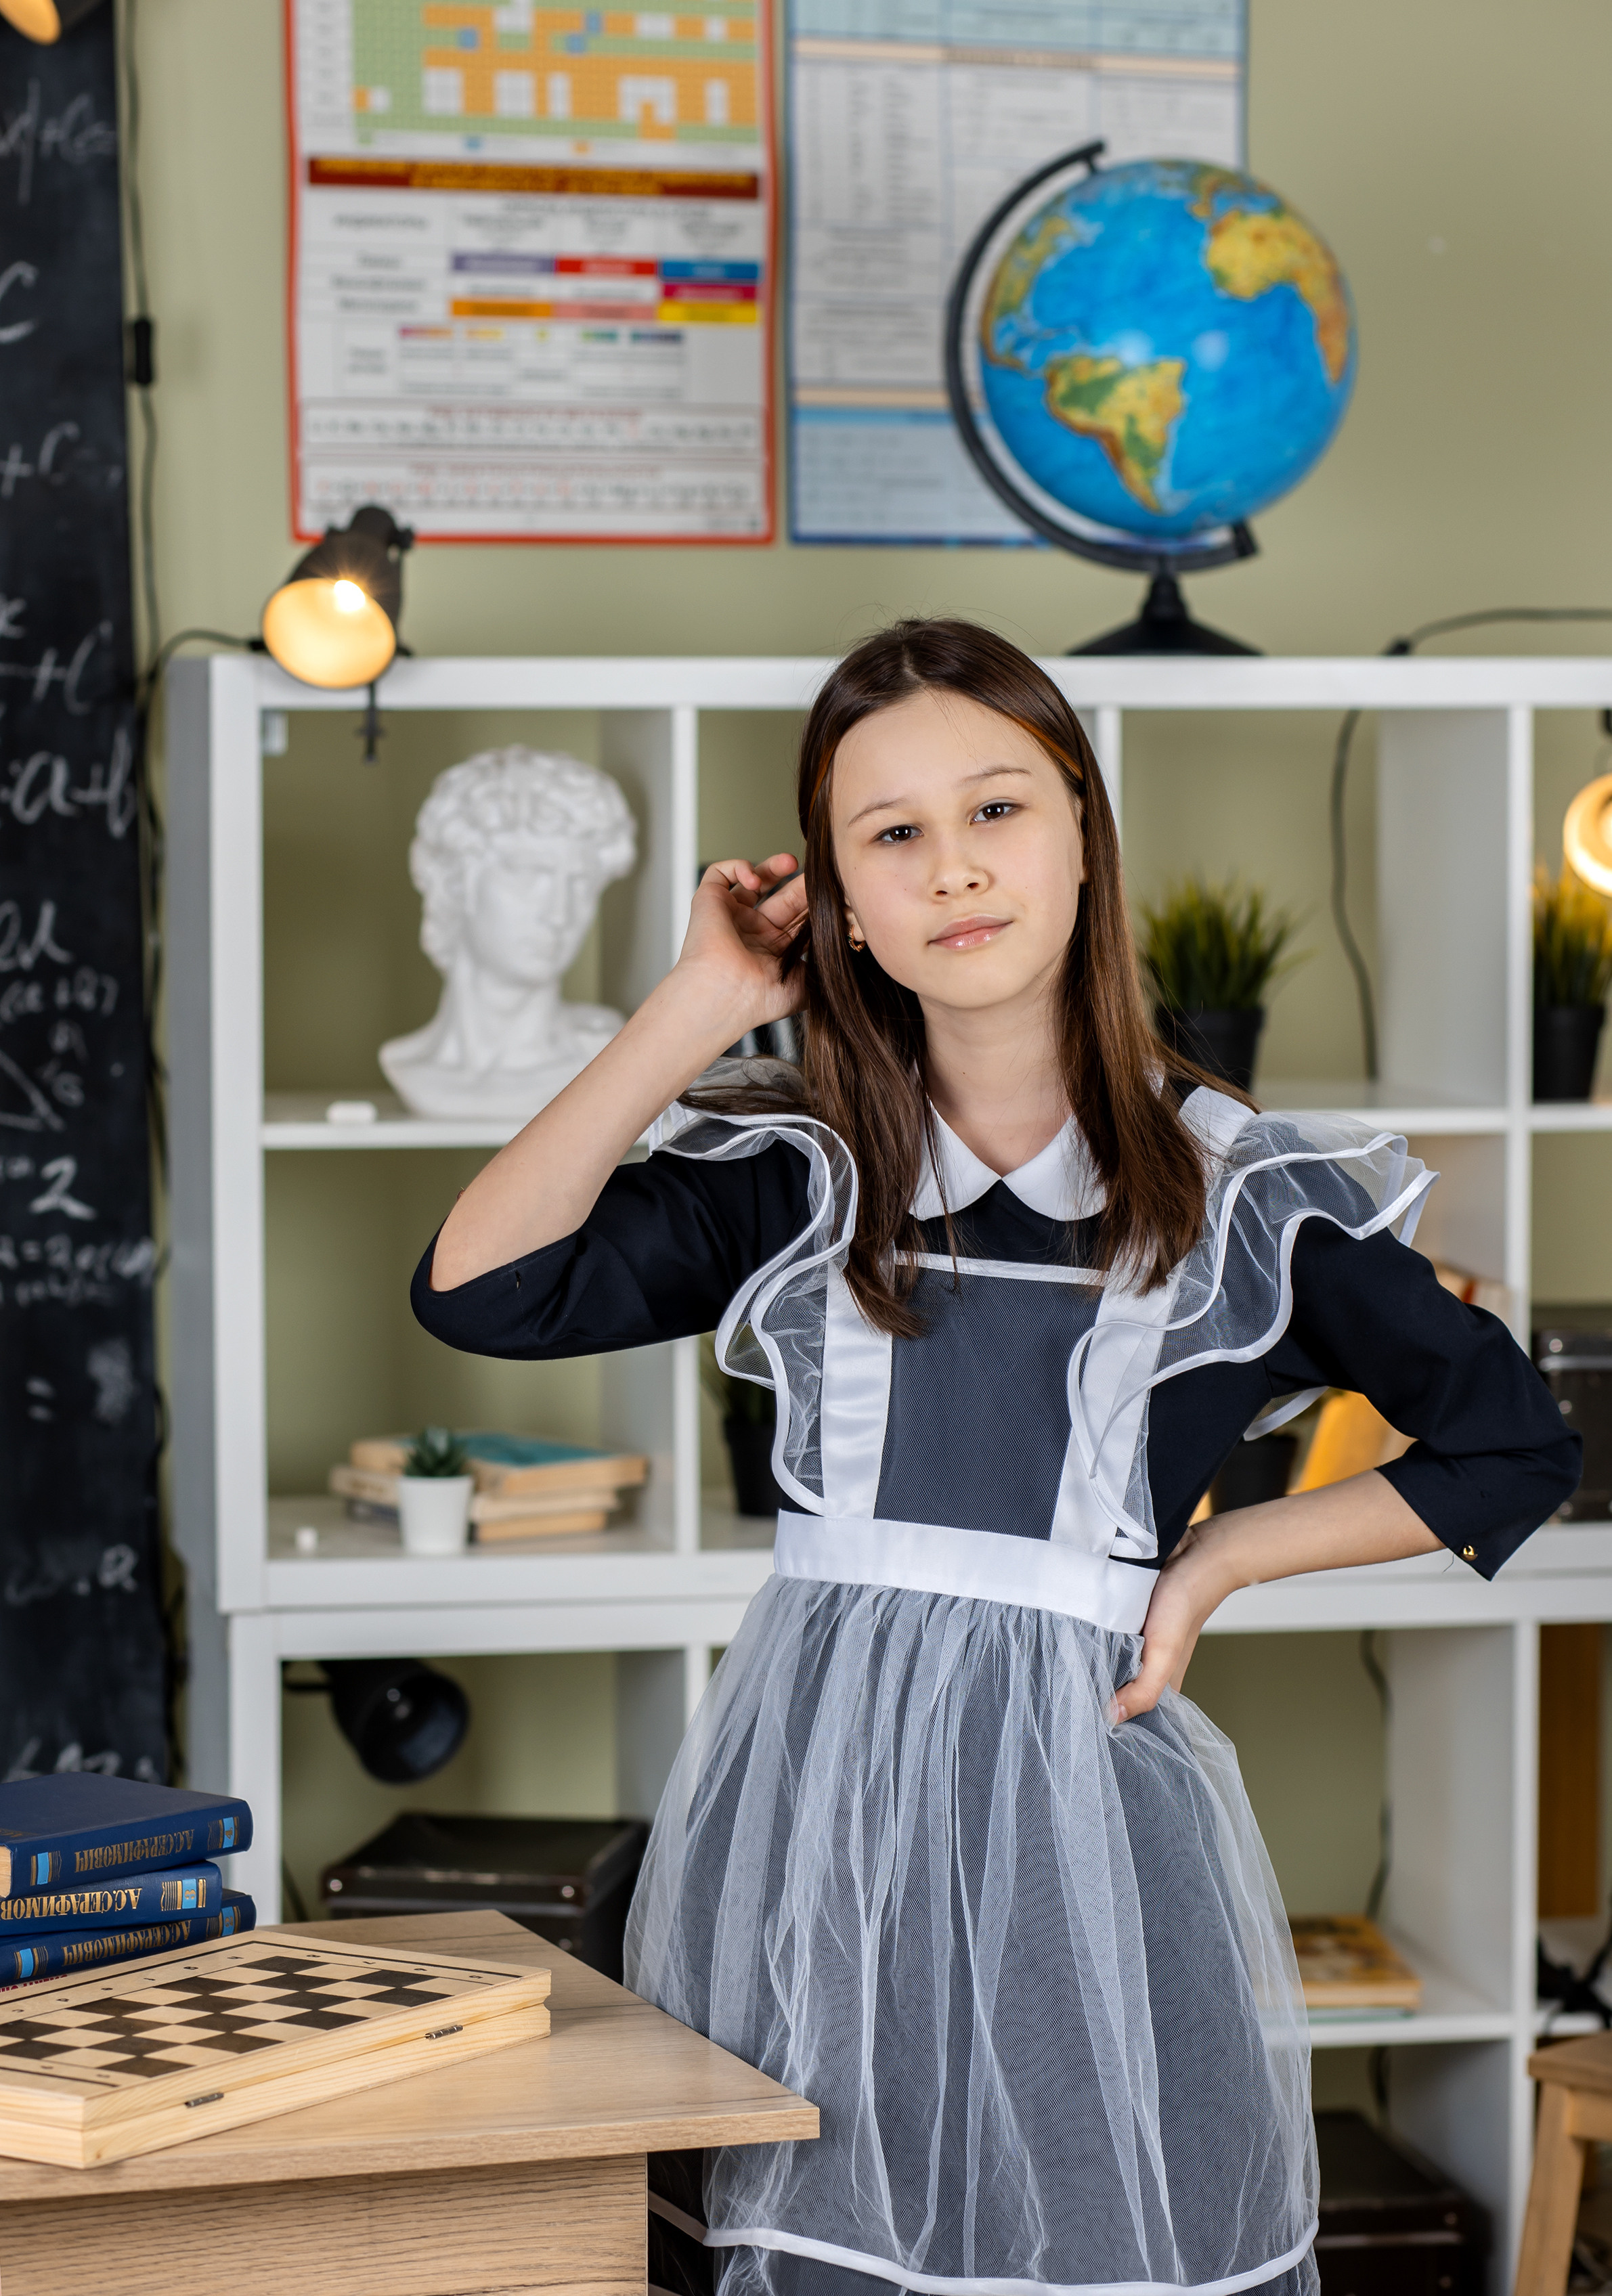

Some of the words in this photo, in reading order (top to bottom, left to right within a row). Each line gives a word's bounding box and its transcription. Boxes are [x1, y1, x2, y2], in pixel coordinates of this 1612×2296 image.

[184, 1889, 196, 1901] 3
[0, 1888, 143, 1921] А.С.СЕРАФИМОВ
[224, 1916, 234, 1928] 2
